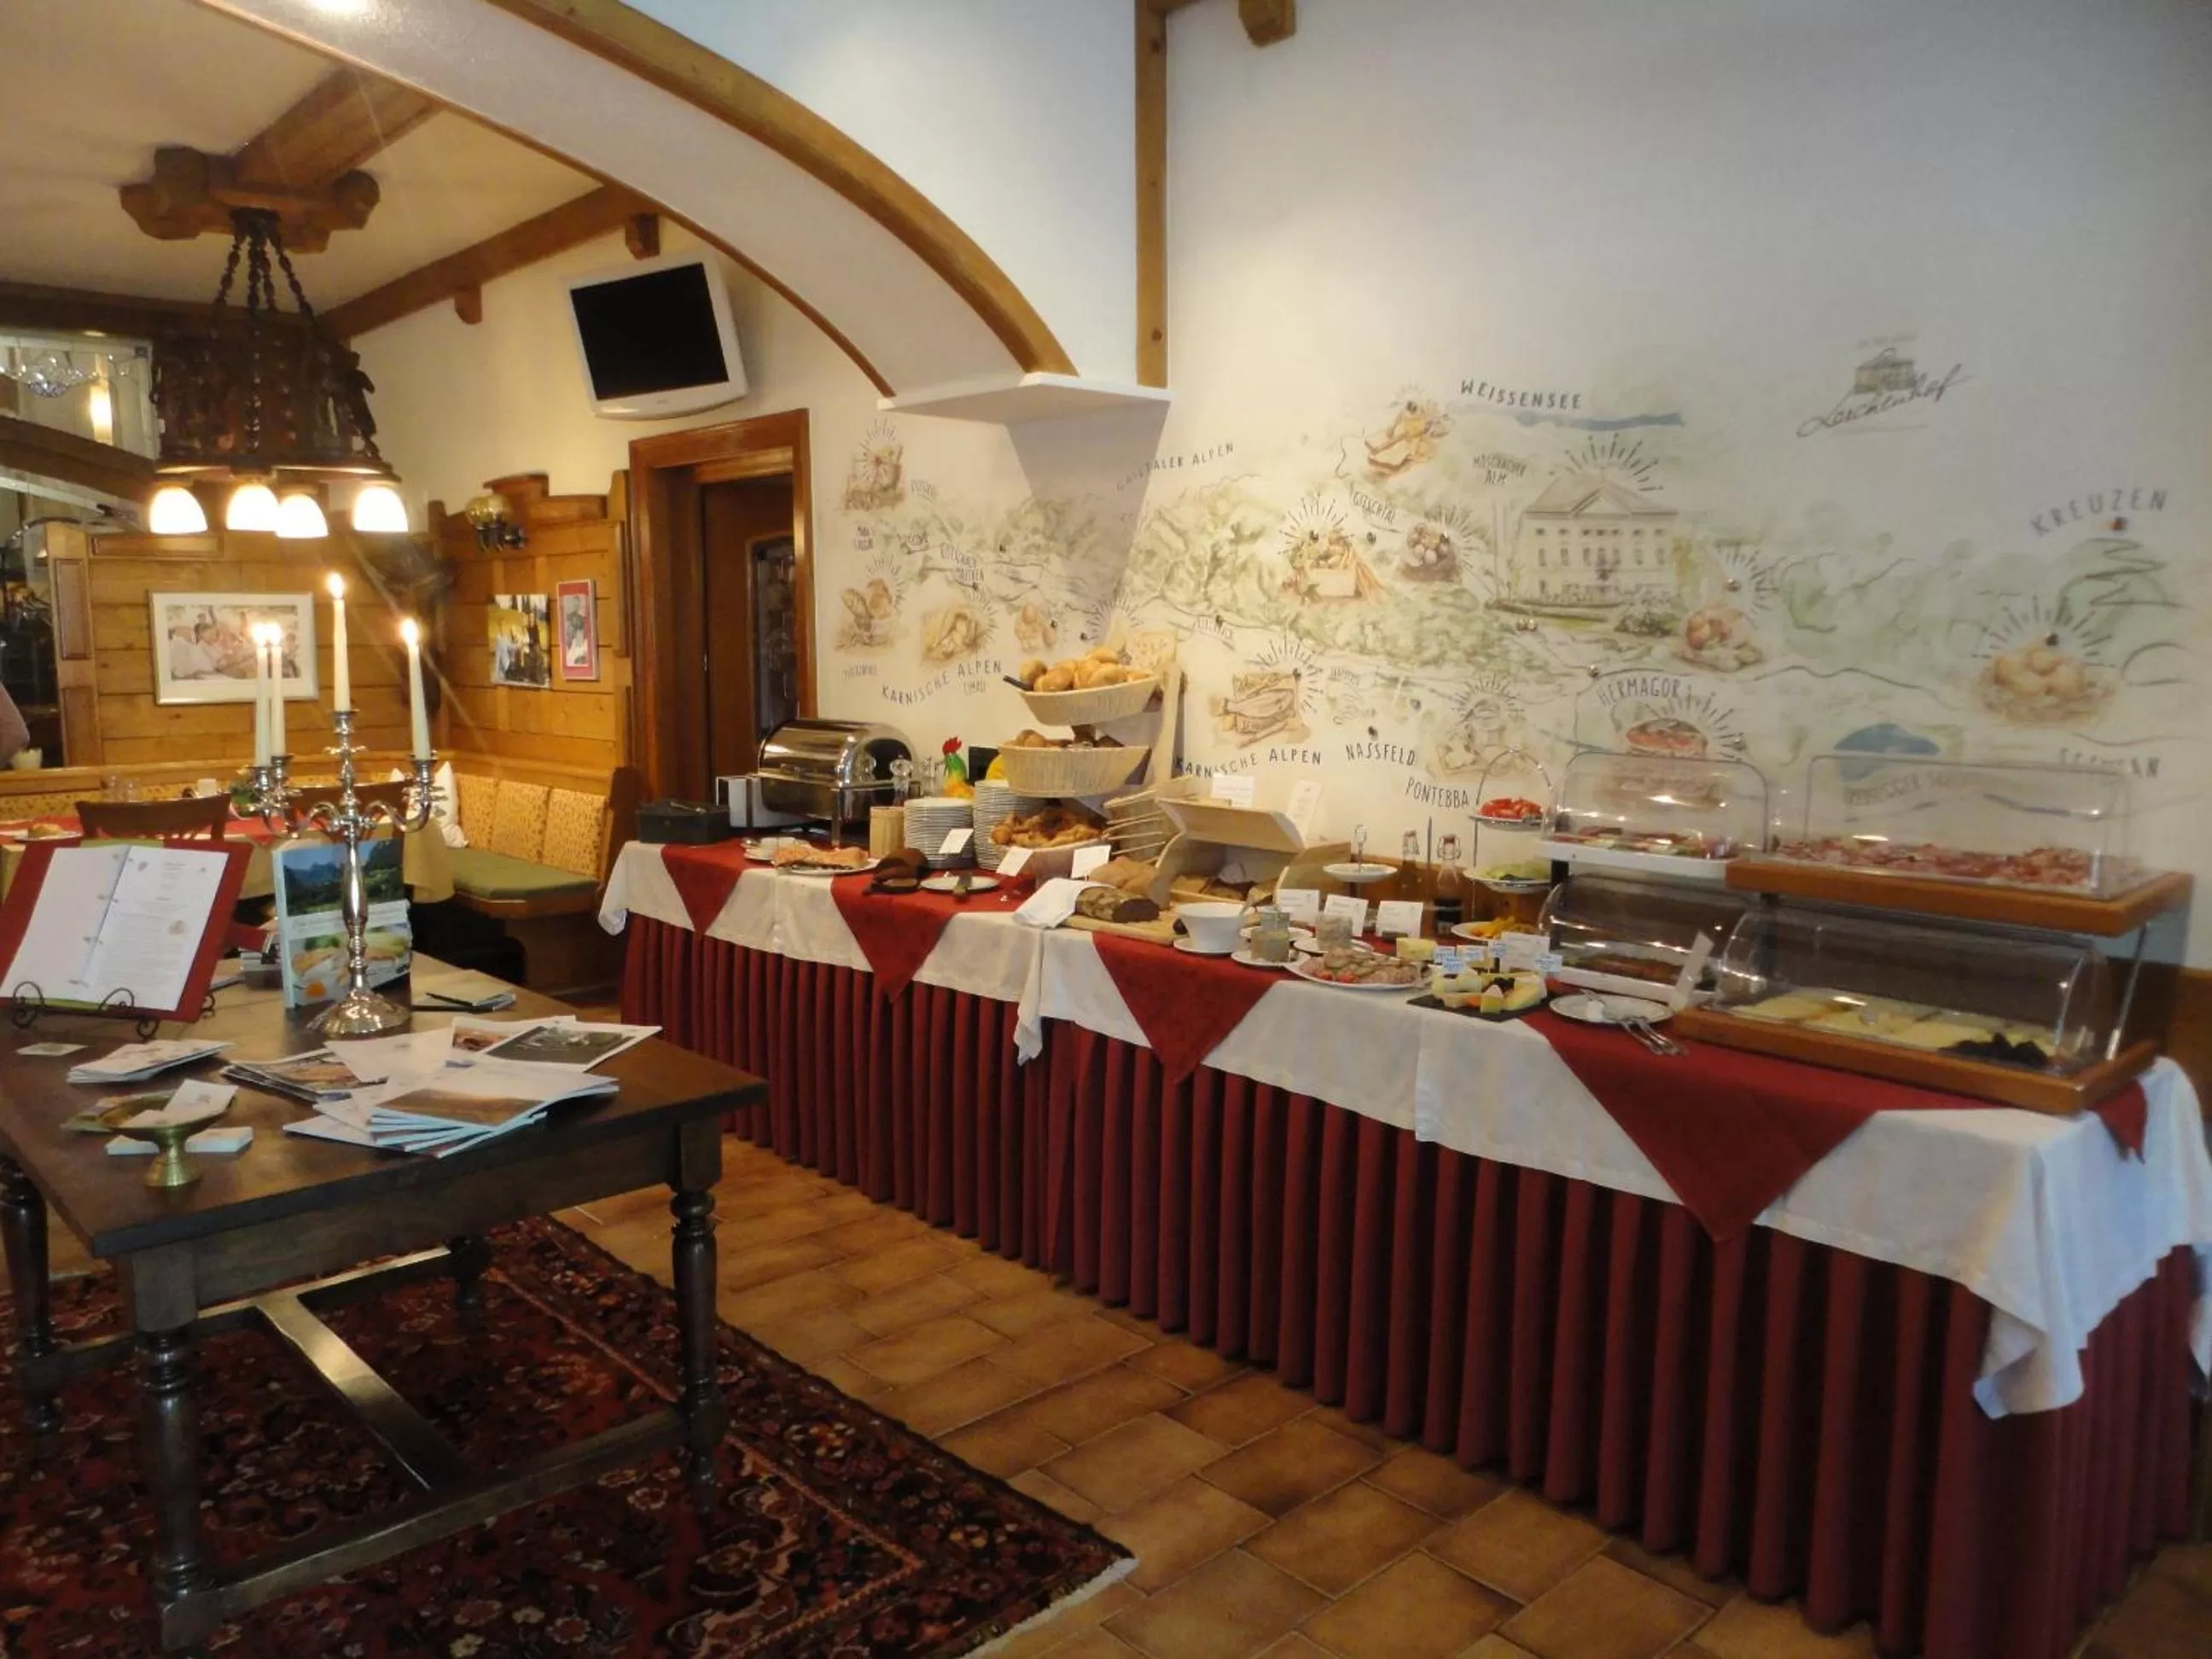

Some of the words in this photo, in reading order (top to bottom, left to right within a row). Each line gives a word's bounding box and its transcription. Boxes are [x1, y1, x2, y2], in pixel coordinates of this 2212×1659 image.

[1460, 379, 1582, 410] WEISSENSEE
[2029, 487, 2168, 538] KREUZEN
[957, 660, 1002, 678] ALPEN
[1595, 676, 1680, 707] HERMAGOR
[1269, 748, 1322, 765] ALPEN
[1345, 743, 1417, 766] NASSFELD
[1405, 777, 1470, 809] PONTEBBA
